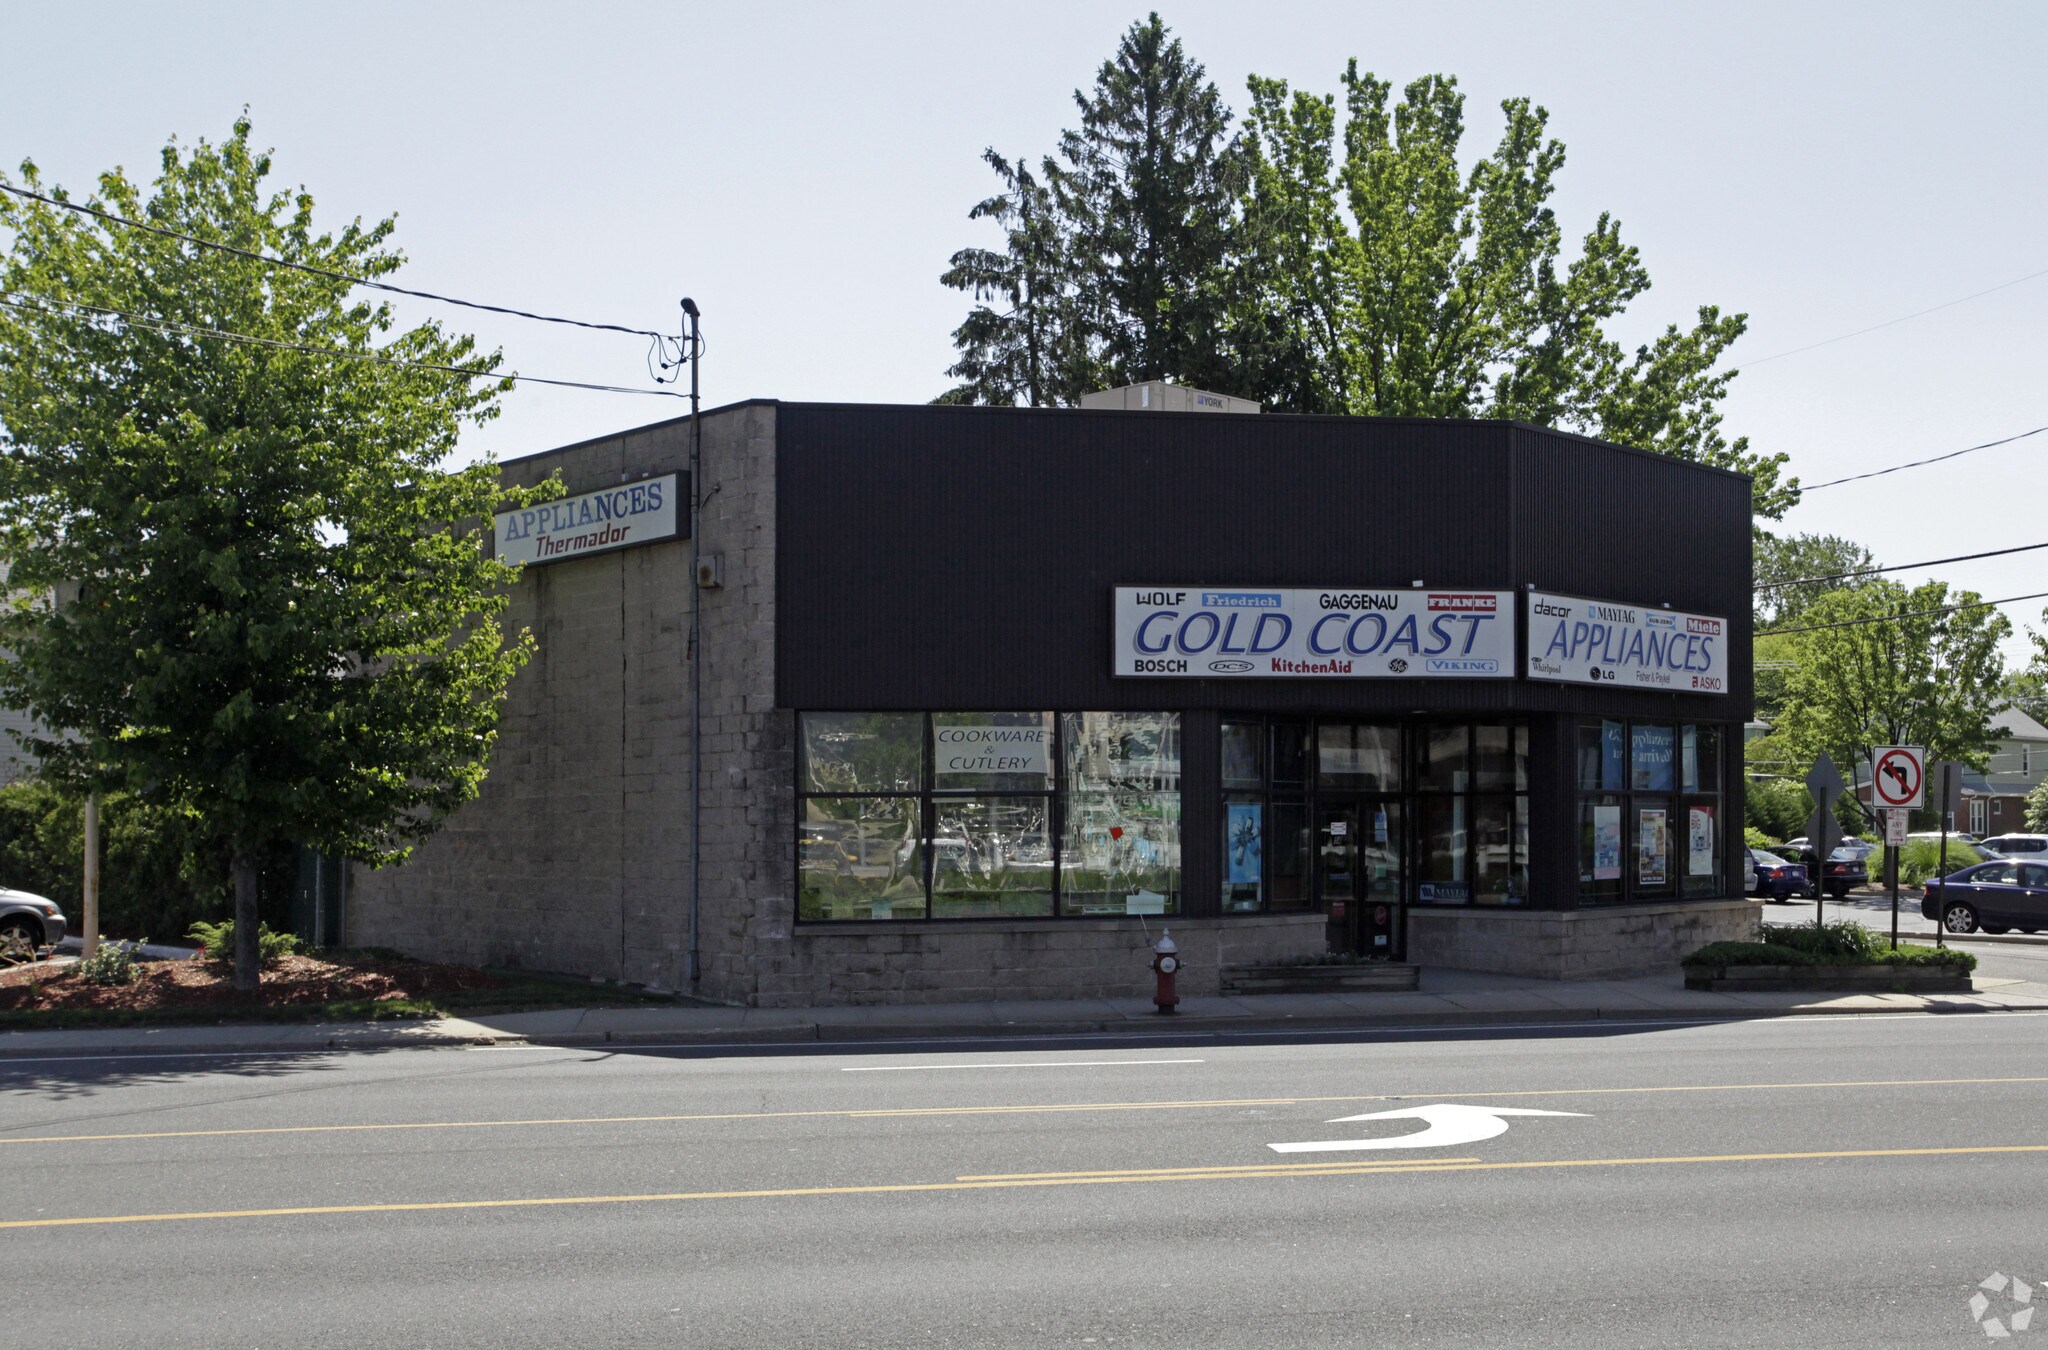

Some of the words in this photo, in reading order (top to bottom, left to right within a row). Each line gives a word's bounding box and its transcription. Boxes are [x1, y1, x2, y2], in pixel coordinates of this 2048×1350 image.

[1204, 397, 1223, 409] YORK
[504, 482, 663, 541] APPLIANCES
[536, 523, 631, 557] Thermador
[1136, 592, 1187, 606] WOLF
[1205, 595, 1279, 607] Friedrich
[1319, 594, 1398, 610] GAGGENAU
[1428, 595, 1496, 610] FRANKE
[1534, 598, 1571, 618] dacor
[1597, 606, 1635, 624] MAYTAG
[1649, 617, 1674, 626] SUB-ZERO
[1687, 618, 1720, 634] Miele
[1133, 611, 1293, 655] GOLD
[1306, 613, 1495, 657] COAST
[1544, 619, 1714, 674] APPLIANCES
[1134, 659, 1188, 673] BOSCH
[1213, 662, 1250, 671] DCS
[1271, 657, 1354, 674] KitchenAid
[1430, 660, 1495, 671] VIKING
[1532, 661, 1562, 675] Whirlpool
[1602, 670, 1615, 680] LG
[1636, 671, 1650, 681] Fisher
[1655, 672, 1671, 686] Paykel
[1700, 677, 1721, 690] ASKO
[939, 730, 1045, 743] COOKWARE
[984, 745, 995, 754] &
[949, 757, 1032, 769] CUTLERY
